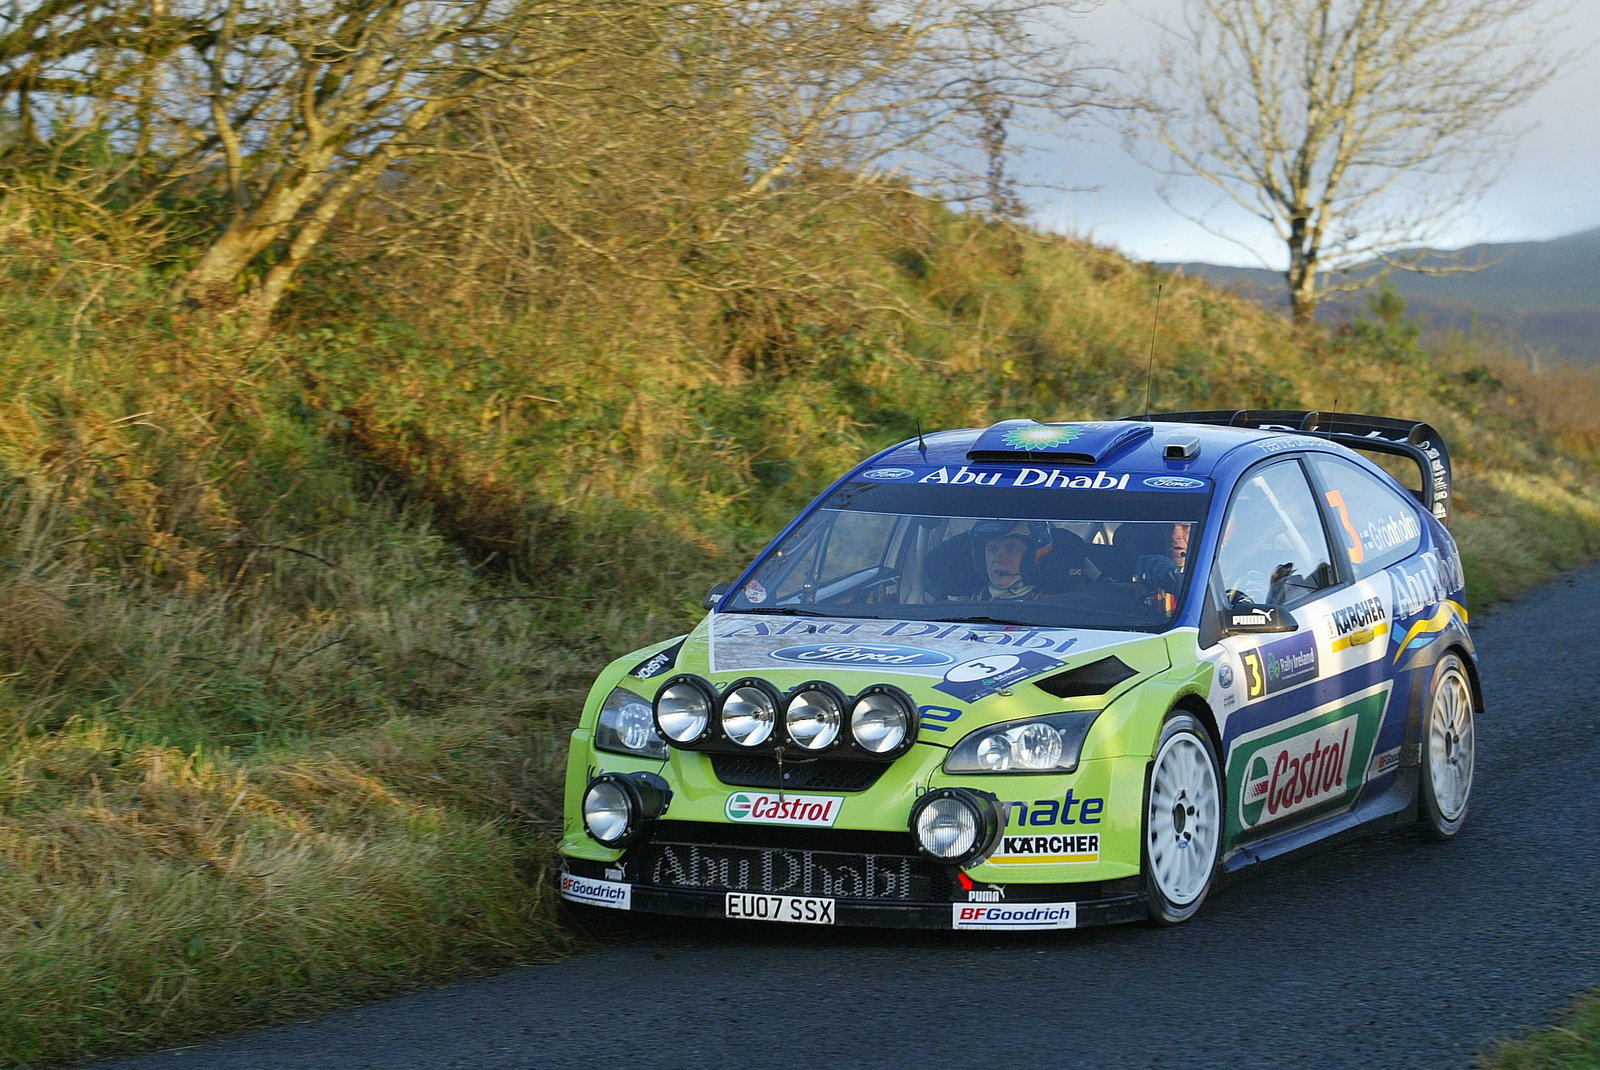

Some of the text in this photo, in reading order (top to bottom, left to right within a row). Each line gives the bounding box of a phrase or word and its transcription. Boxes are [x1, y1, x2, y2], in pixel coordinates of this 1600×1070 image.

[918, 466, 1131, 491] Abu Dhabi
[1153, 477, 1194, 488] Ford
[1325, 489, 1364, 564] 3
[721, 620, 1079, 654] Abu Dhabi
[797, 645, 924, 665] Ford
[968, 662, 998, 675] 3
[1244, 653, 1263, 697] 3
[1267, 727, 1350, 816] Castrol
[751, 796, 833, 822] Castrol
[1003, 835, 1099, 854] KÄRCHER
[652, 845, 911, 900] Abu Dhabi
[562, 878, 626, 900] BFGoodrich
[968, 890, 1000, 902] PUMA
[727, 894, 834, 923] EU07 SSX
[959, 907, 1071, 921] BFGoodrich
